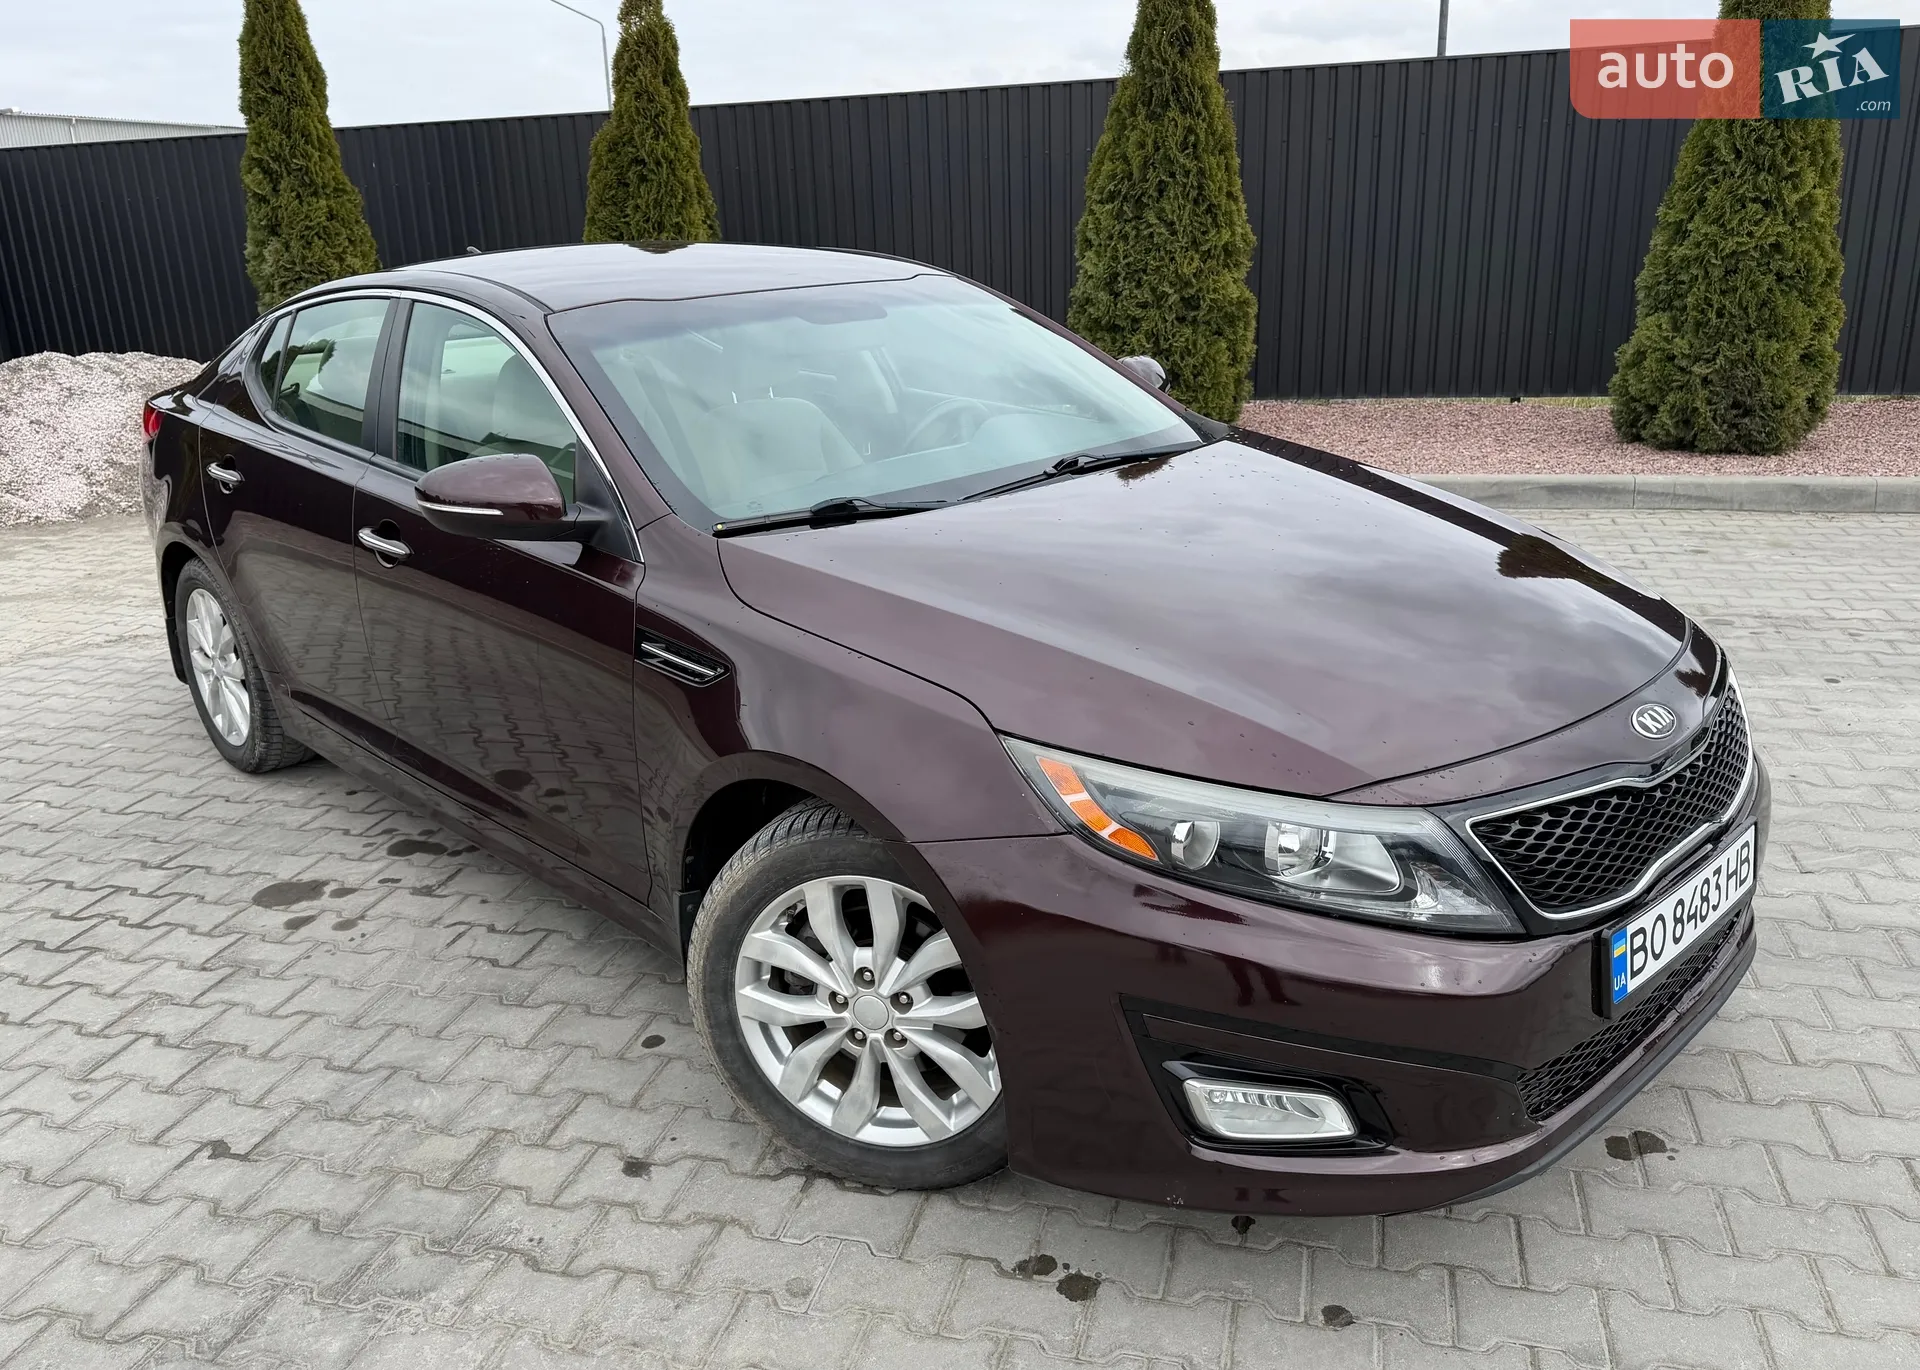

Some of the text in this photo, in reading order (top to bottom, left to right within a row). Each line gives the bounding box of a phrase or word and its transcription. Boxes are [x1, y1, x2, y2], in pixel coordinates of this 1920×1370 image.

[1637, 706, 1675, 733] KIA
[1630, 839, 1751, 981] BO 8483 HB
[1614, 972, 1627, 991] UA
